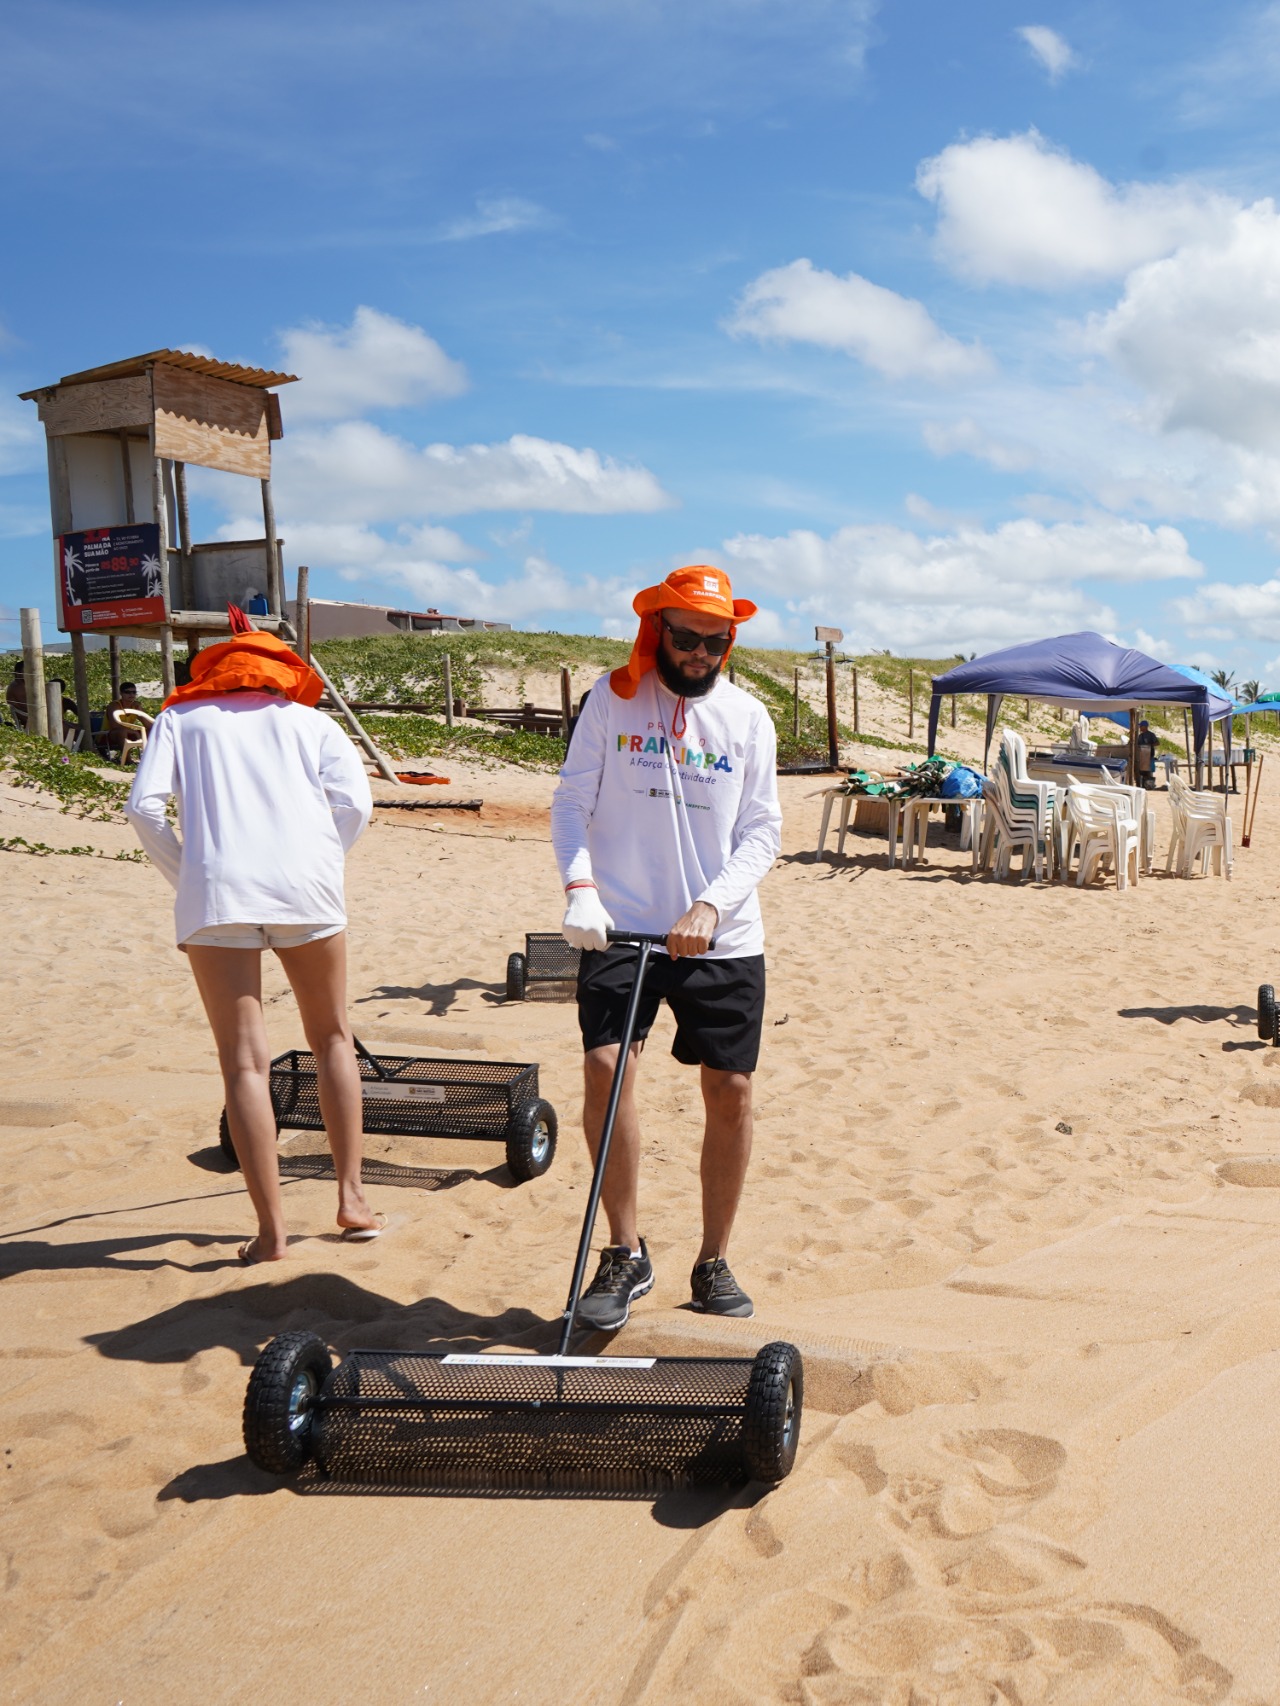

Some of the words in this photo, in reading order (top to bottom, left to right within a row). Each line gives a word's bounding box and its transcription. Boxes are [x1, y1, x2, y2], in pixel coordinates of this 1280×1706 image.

[95, 549, 109, 557] MÃO
[630, 758, 636, 767] A
[637, 757, 663, 770] Força
